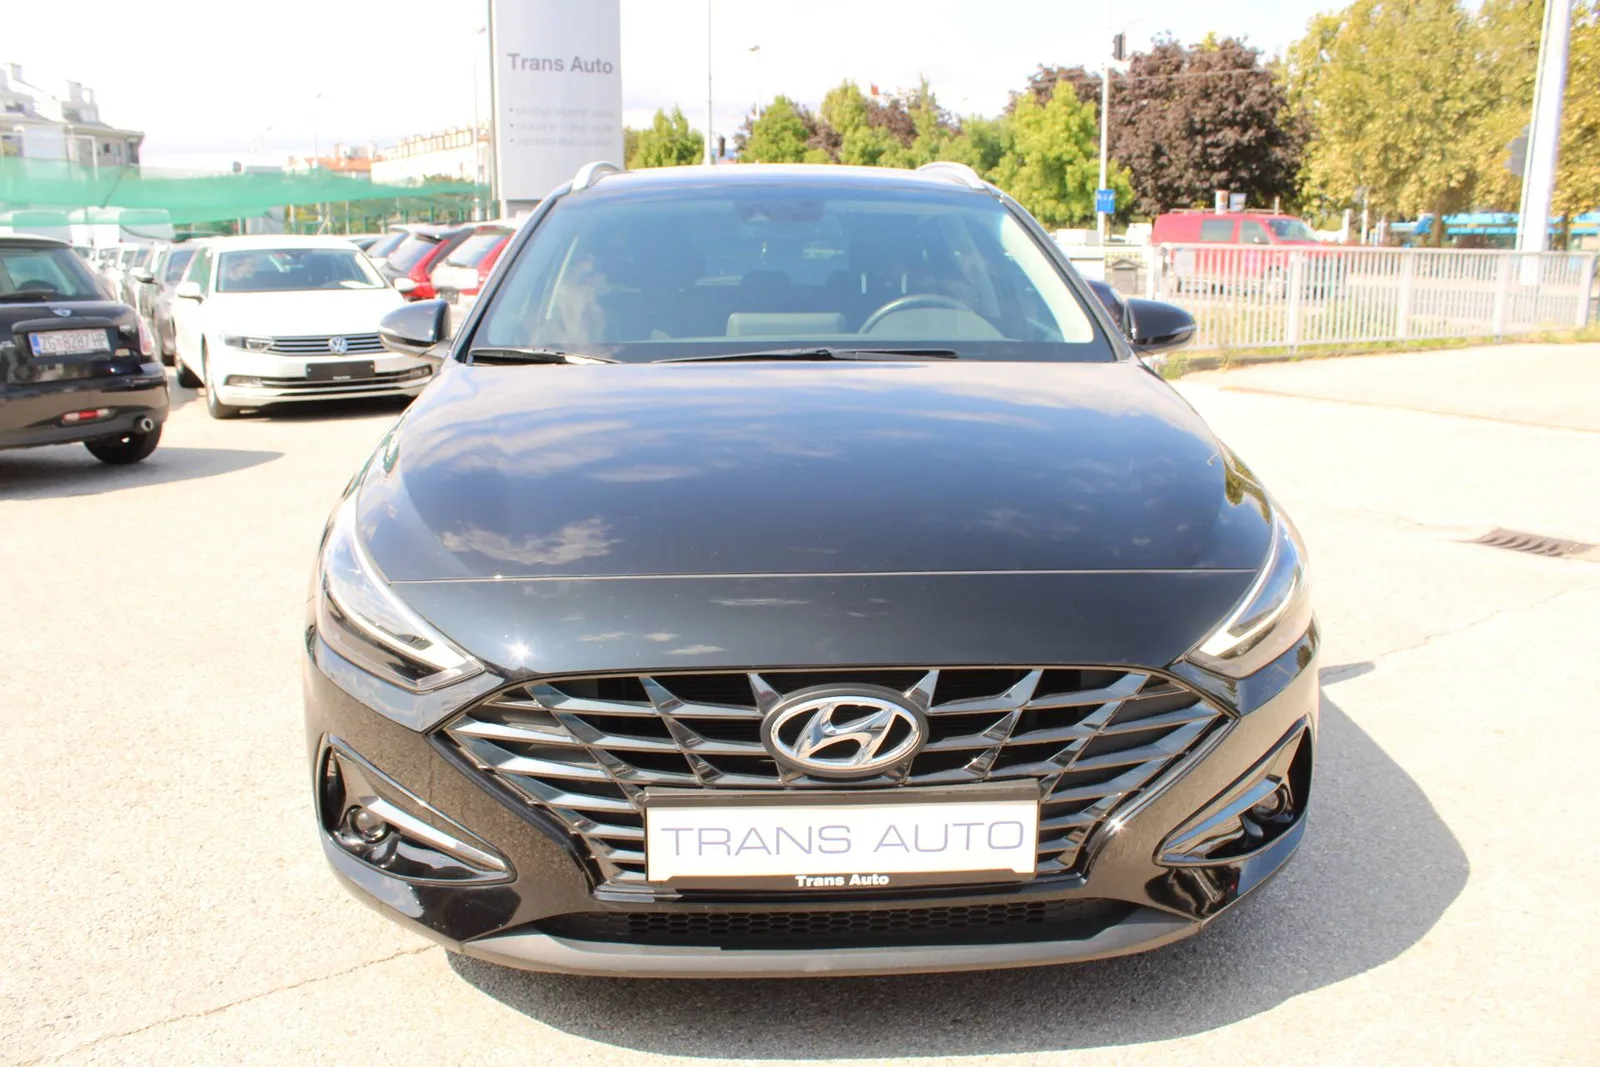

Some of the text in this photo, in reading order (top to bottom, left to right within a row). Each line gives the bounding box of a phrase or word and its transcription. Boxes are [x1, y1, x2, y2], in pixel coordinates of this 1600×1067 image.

[507, 53, 613, 74] Trans Auto
[660, 820, 1024, 856] TRANS AUTO
[795, 874, 889, 887] Trans Auto
